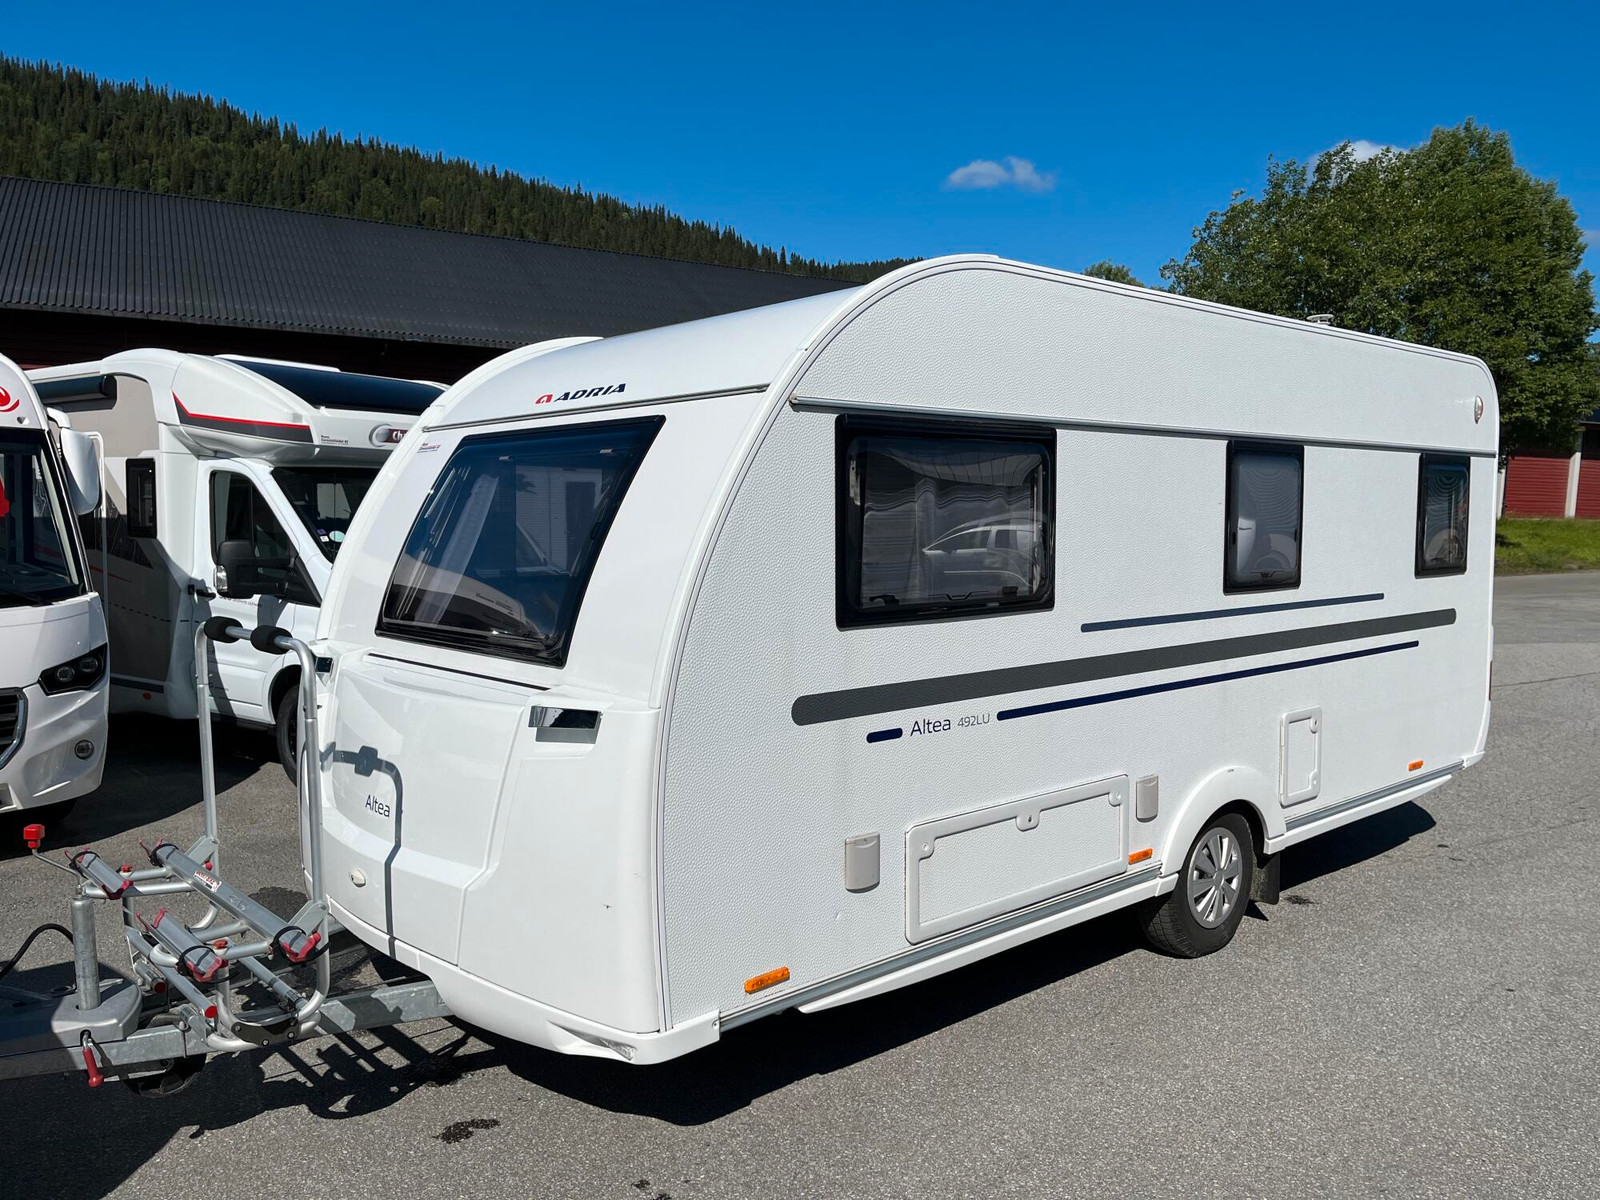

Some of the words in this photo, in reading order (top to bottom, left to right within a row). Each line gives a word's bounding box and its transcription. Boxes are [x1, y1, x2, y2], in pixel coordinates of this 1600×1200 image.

[554, 383, 626, 402] ADRIA
[910, 719, 951, 736] Altea
[957, 713, 990, 728] 492LU
[365, 794, 391, 818] Altea
